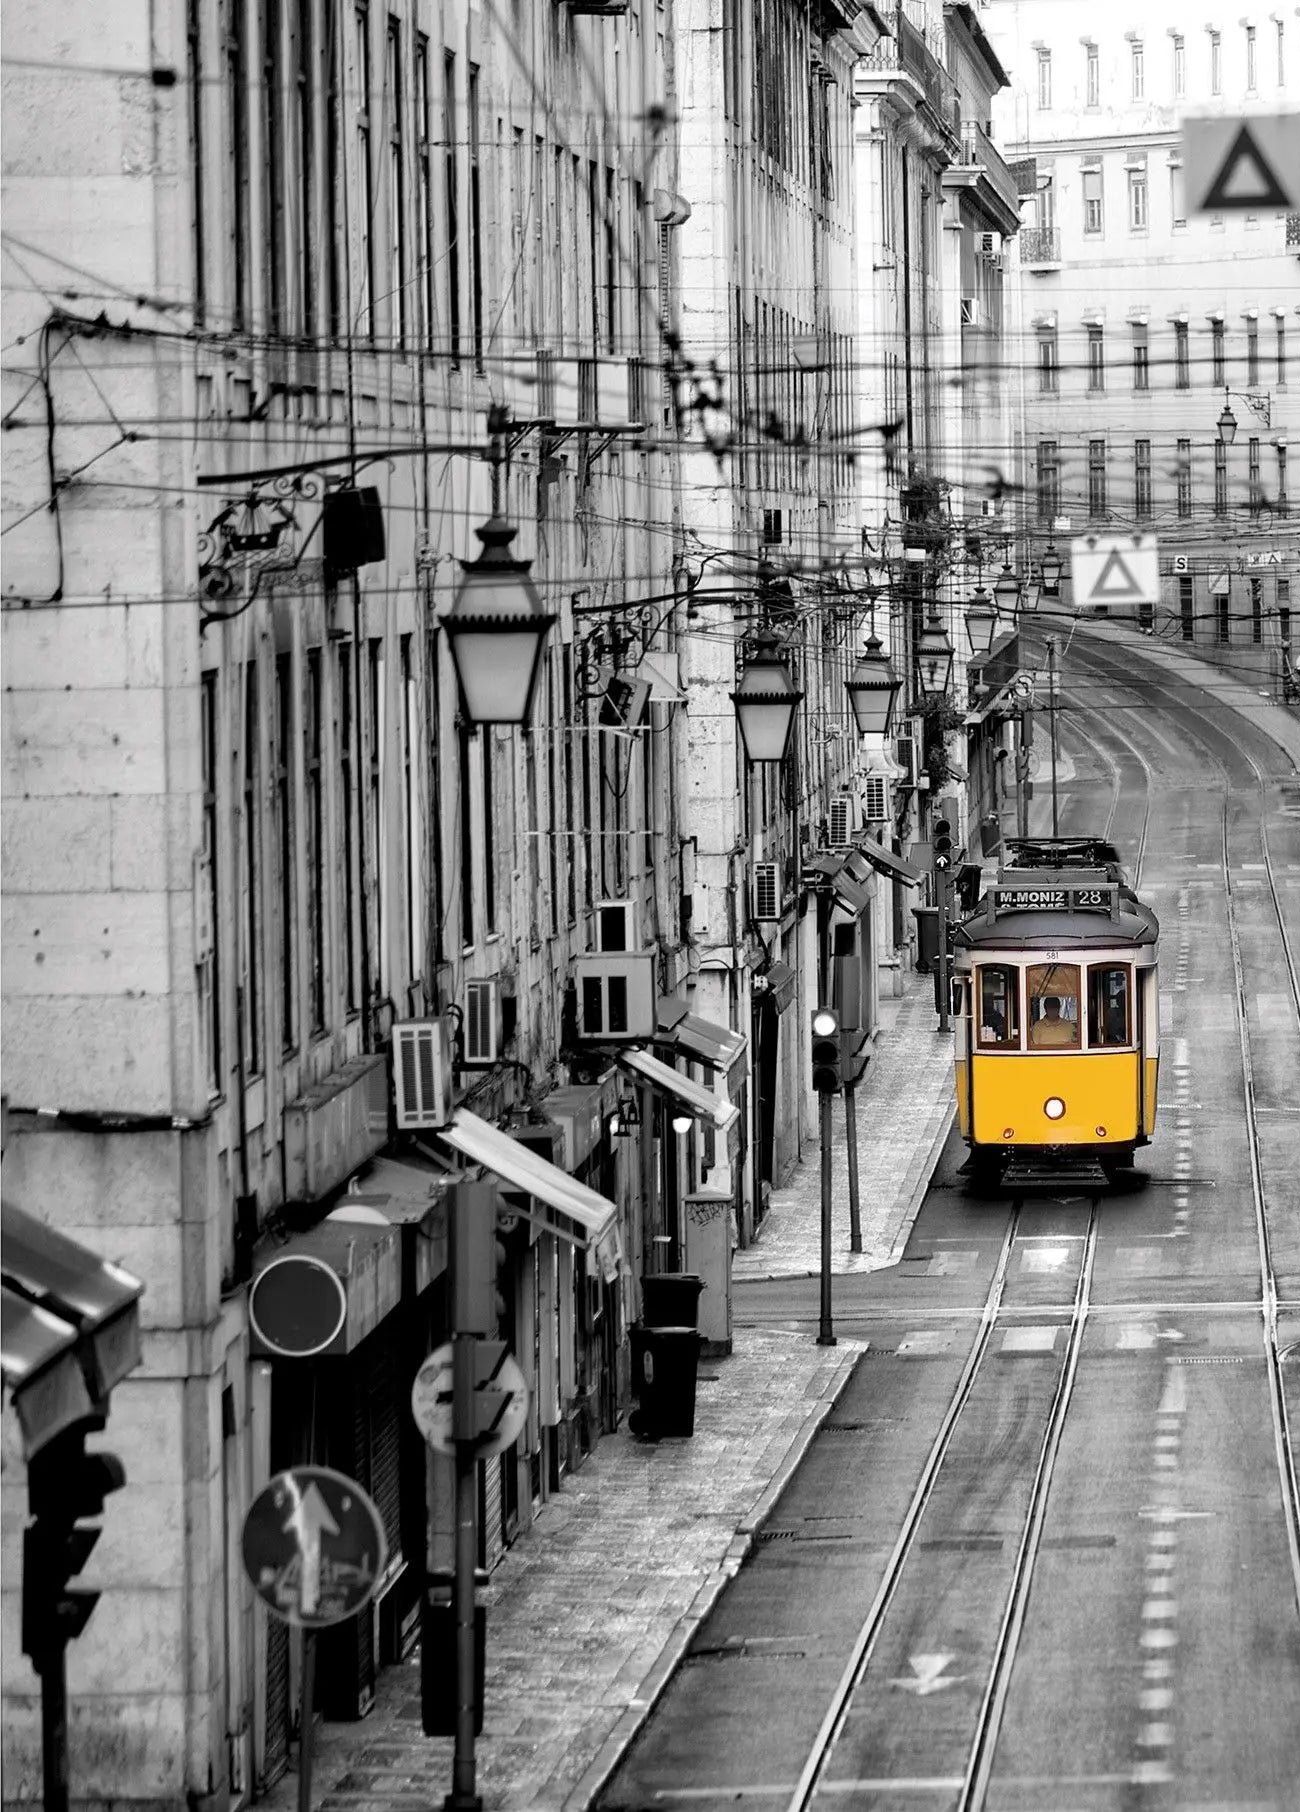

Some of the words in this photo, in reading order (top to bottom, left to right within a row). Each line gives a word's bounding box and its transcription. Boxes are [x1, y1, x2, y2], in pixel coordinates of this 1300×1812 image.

[1176, 557, 1186, 570] S
[1000, 891, 1065, 903] M.MONIZ
[1079, 890, 1102, 905] 28
[1046, 952, 1059, 960] 581
